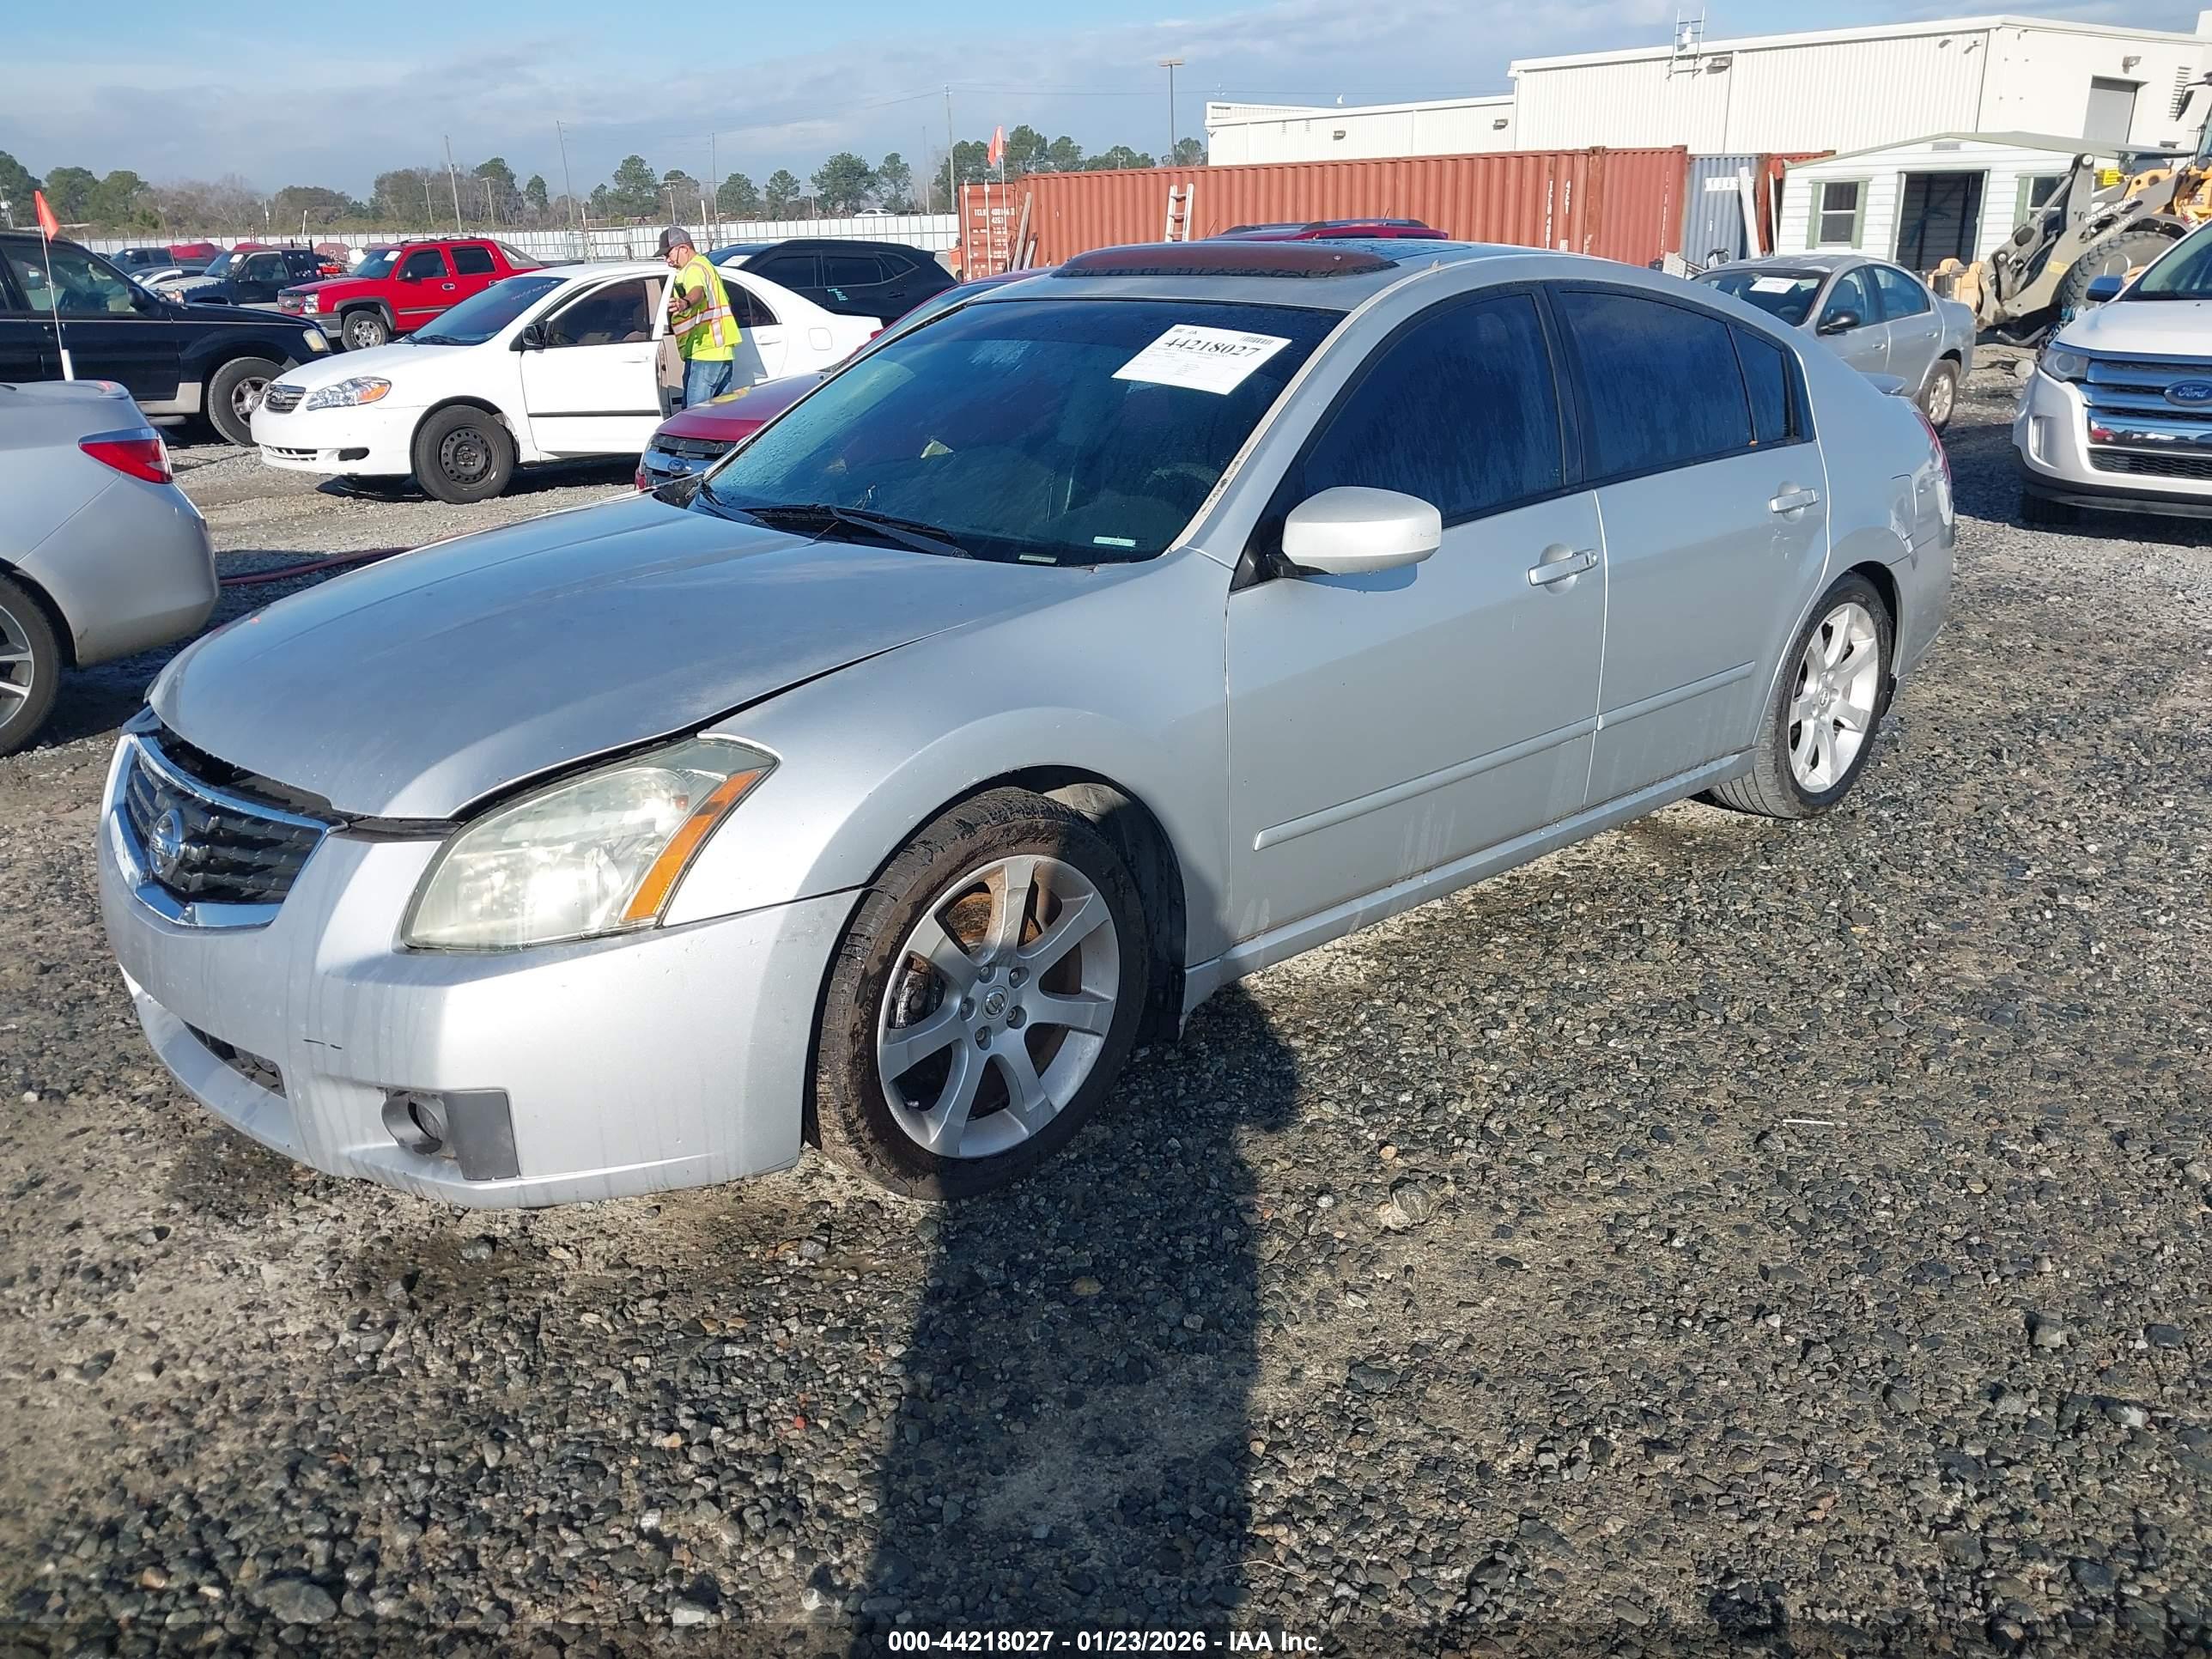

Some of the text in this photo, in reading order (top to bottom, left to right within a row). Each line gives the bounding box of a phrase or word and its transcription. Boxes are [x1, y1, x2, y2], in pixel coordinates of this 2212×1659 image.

[2085, 215, 2098, 224] DO
[2098, 205, 2114, 219] NOT
[2115, 215, 2135, 230] MAST
[1164, 337, 1262, 357] 44218027
[2178, 386, 2209, 398] Ford
